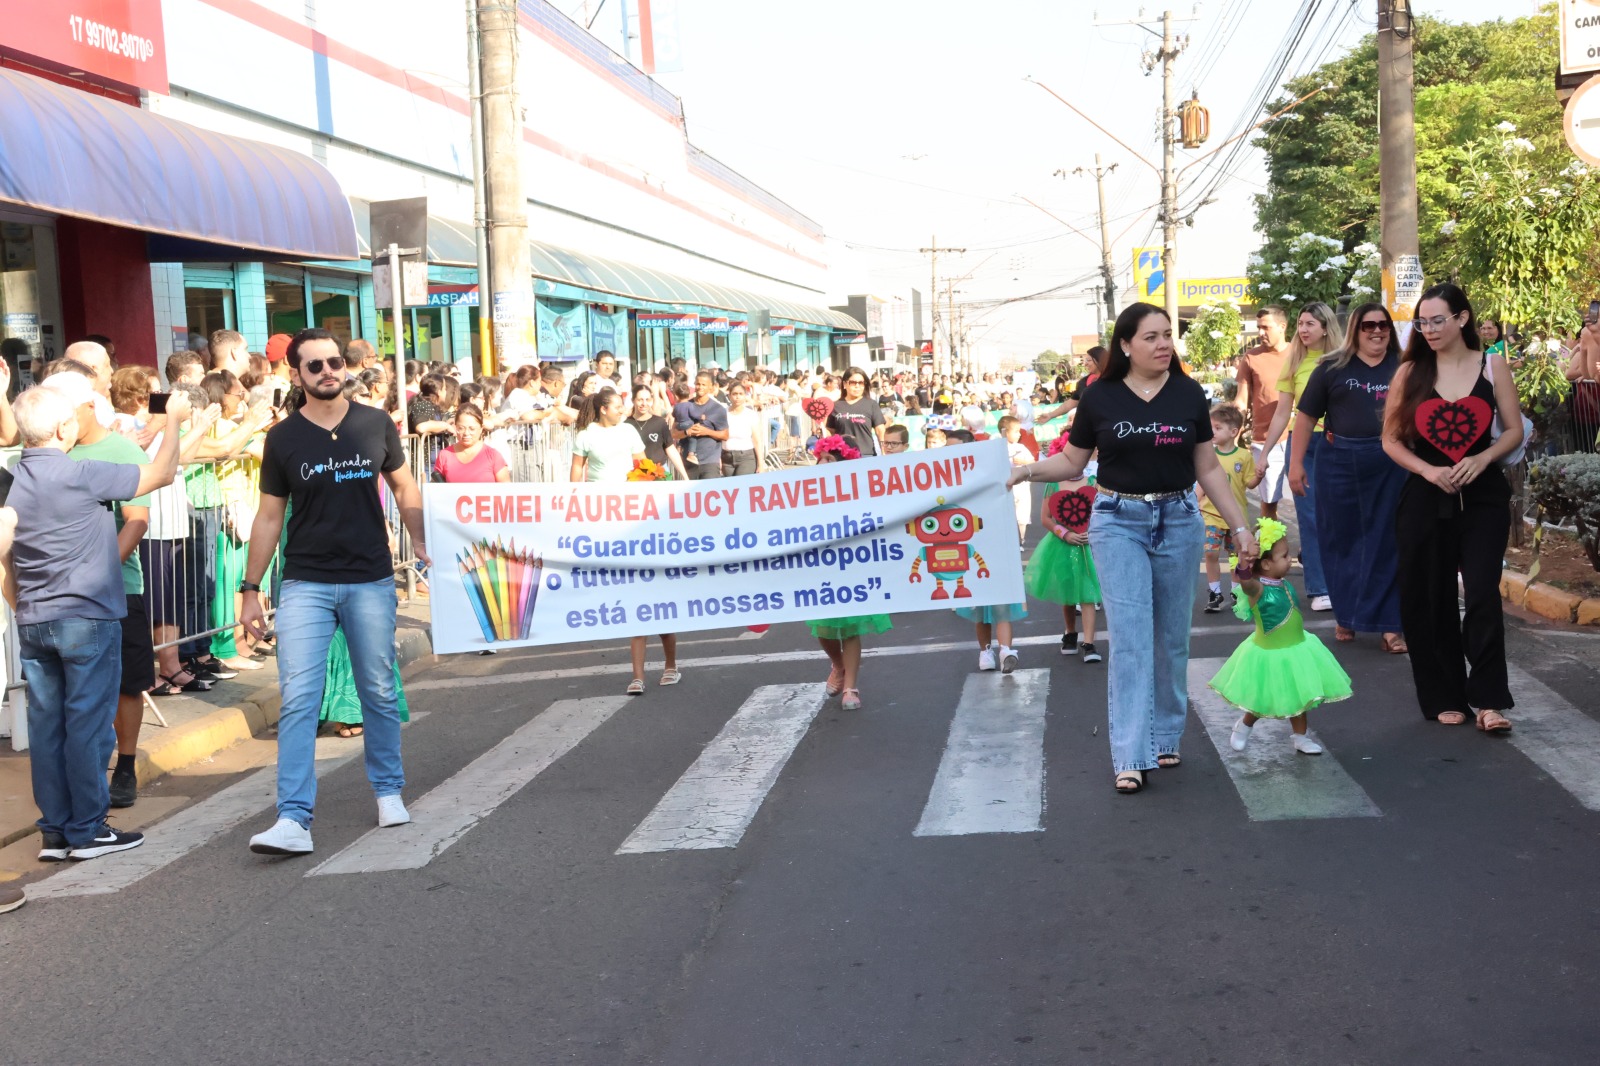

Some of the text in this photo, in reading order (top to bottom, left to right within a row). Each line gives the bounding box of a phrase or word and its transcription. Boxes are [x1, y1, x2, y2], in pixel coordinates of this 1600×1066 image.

[70, 14, 146, 62] 17 99702-8070
[1575, 15, 1600, 28] CAM
[455, 495, 541, 523] CEMEI
[669, 489, 740, 519] LUCY
[750, 472, 859, 513] RAVELLI
[725, 528, 757, 549] do
[768, 512, 885, 545] amanhã:
[546, 573, 562, 591] o
[571, 566, 656, 589] futuro
[665, 567, 698, 580] de
[566, 600, 627, 629] está
[636, 601, 678, 623] em
[687, 591, 784, 617] nossas
